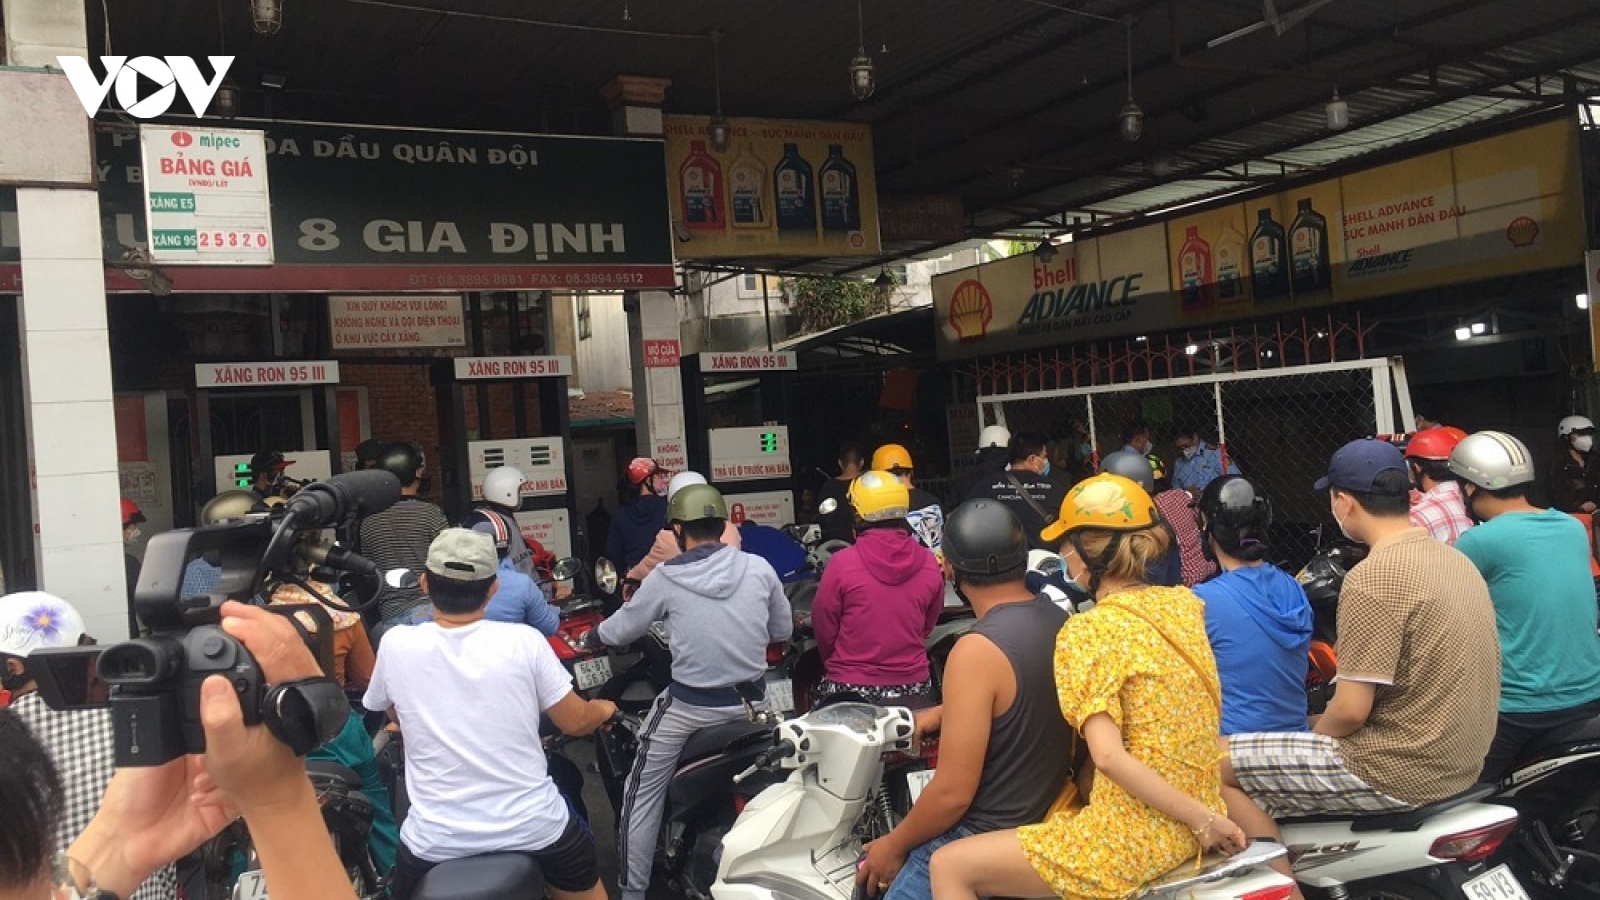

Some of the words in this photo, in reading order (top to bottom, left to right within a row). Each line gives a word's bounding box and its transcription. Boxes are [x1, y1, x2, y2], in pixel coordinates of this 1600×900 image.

[664, 124, 695, 135] SHELL
[199, 132, 241, 151] mipec
[313, 133, 380, 160] DẦU
[393, 141, 478, 166] QUÂN
[487, 144, 539, 171] ĐỘI
[160, 151, 216, 177] BẢNG
[221, 156, 254, 178] GIÁ
[180, 198, 194, 209] E5
[1342, 209, 1375, 227] SHELL
[1377, 196, 1435, 219] ADVANCE
[183, 235, 197, 247] 95
[297, 217, 341, 252] 8
[362, 218, 468, 254] GIA
[487, 222, 626, 261] ĐỊNH
[1356, 244, 1381, 258] Shell
[1347, 249, 1414, 273] ADVANCE
[531, 274, 562, 285] FAX:
[1033, 256, 1077, 290] Shell
[1016, 273, 1144, 325] ADVANCE
[468, 359, 500, 376] XĂNG
[503, 361, 527, 374] RON
[529, 360, 545, 374] 95
[548, 359, 559, 374] III
[711, 354, 738, 369] XĂNG
[740, 356, 761, 368] RON
[762, 355, 776, 368] 95
[214, 364, 254, 384] XĂNG
[257, 366, 286, 382] RON
[289, 366, 308, 381] 95
[311, 365, 326, 380] III
